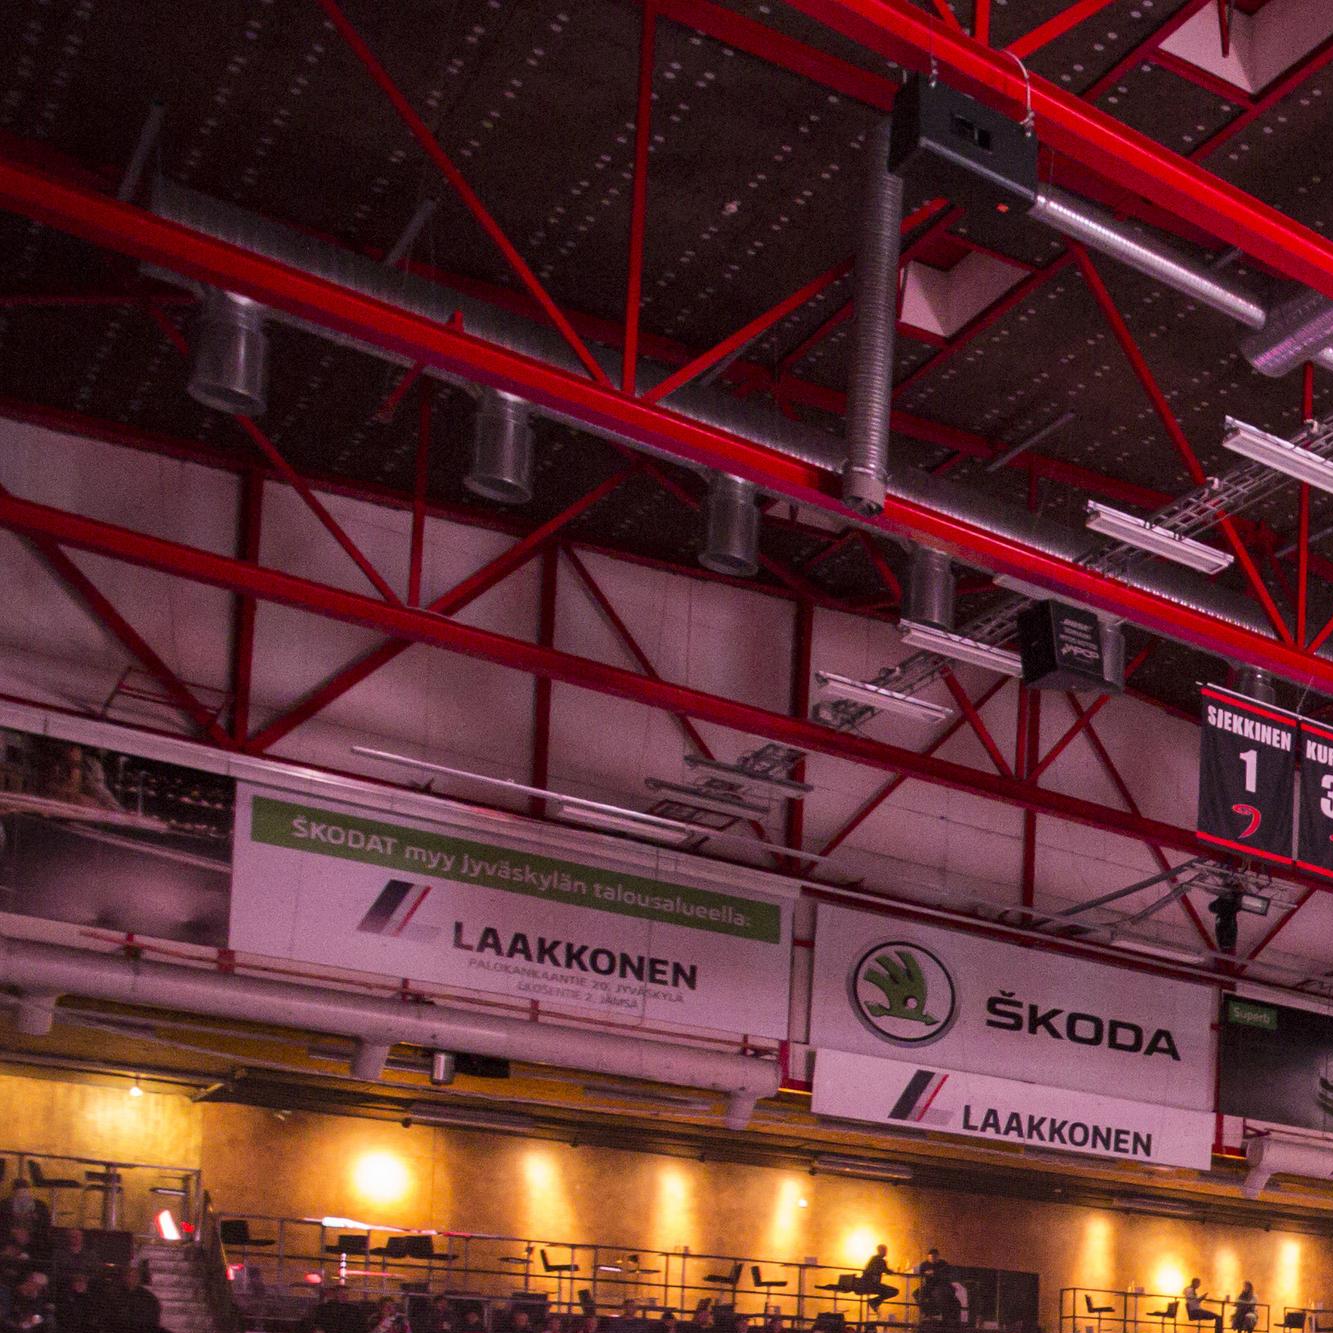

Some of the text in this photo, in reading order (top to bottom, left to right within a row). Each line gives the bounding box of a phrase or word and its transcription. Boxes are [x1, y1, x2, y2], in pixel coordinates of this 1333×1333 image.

[1207, 705, 1292, 752] SIEKKINEN
[1240, 749, 1258, 793] 1
[291, 815, 398, 856] ŠKODAT
[405, 846, 455, 871] myy
[453, 921, 698, 990] LAAKKONEN
[985, 990, 1182, 1062] ŠKODA
[1233, 1006, 1270, 1025] Superb
[962, 1104, 1152, 1157] LAAKKONEN
